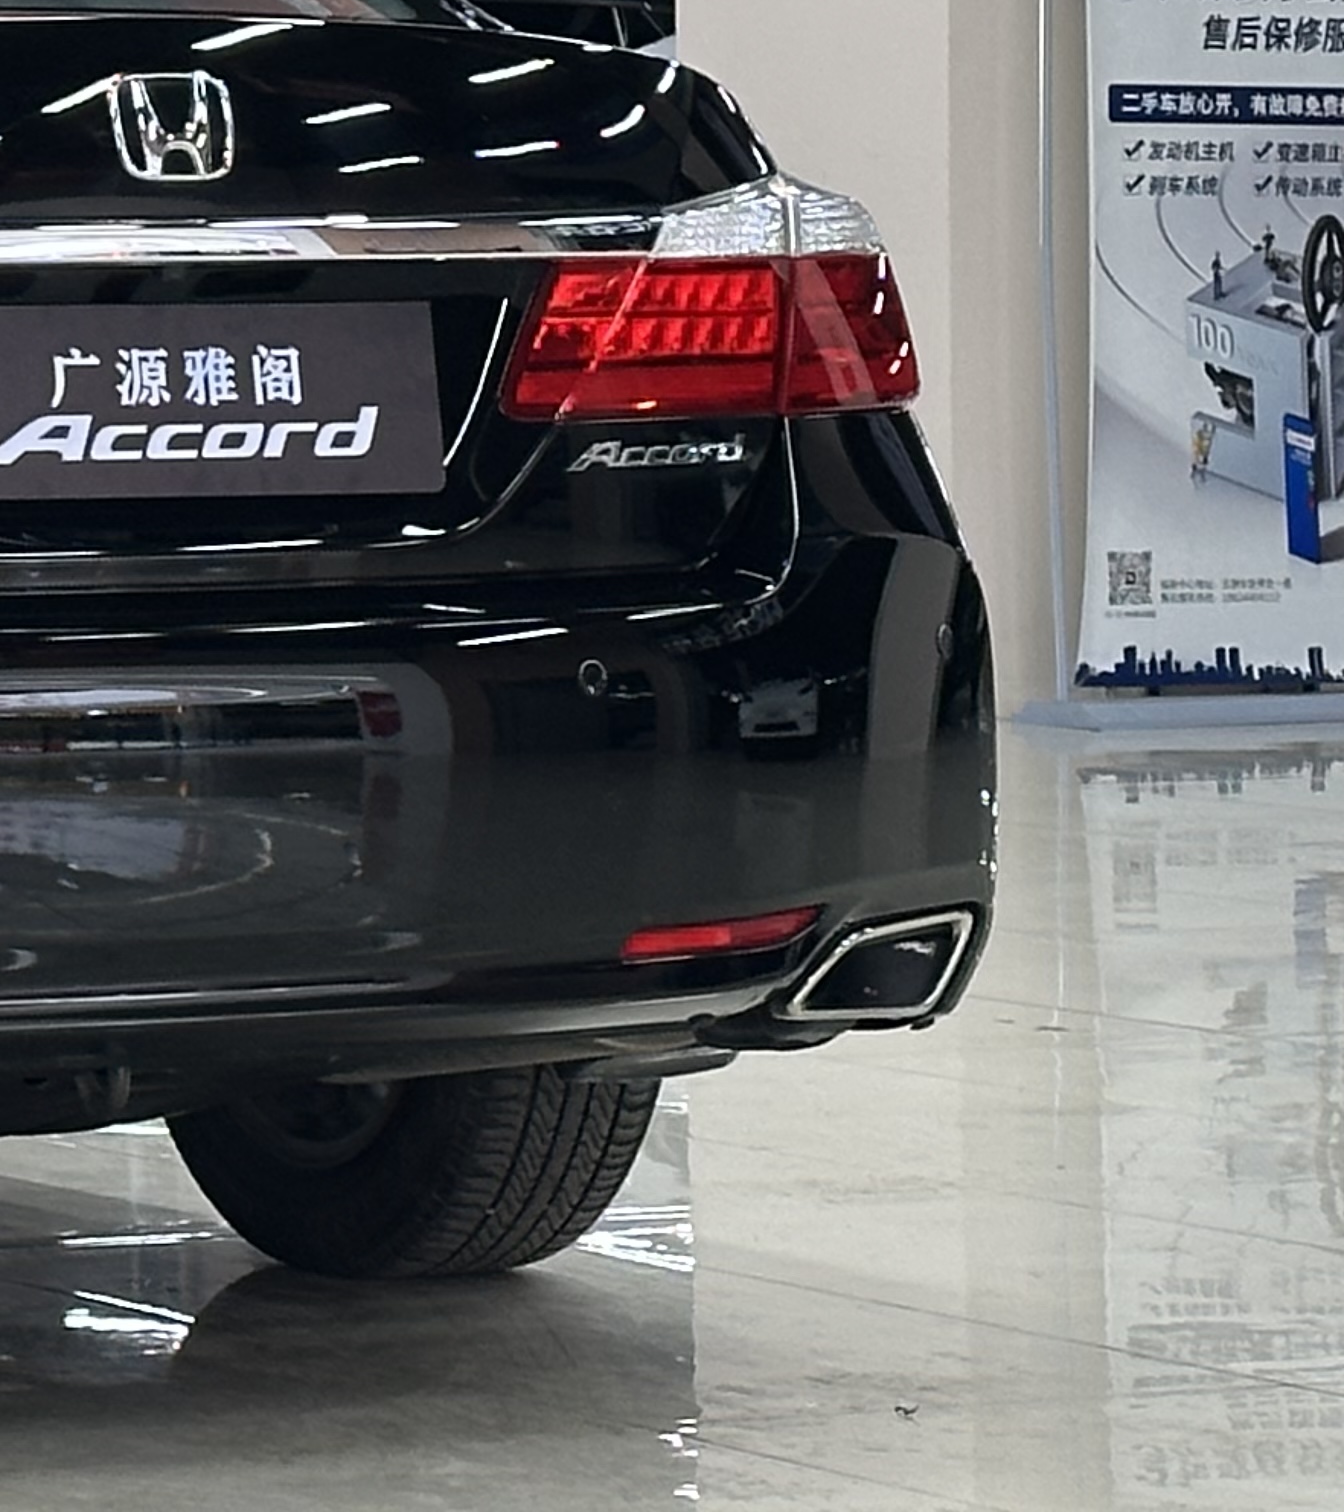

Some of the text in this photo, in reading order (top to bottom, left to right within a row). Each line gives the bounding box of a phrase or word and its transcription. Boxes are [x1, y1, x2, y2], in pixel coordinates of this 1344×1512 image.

[48, 344, 304, 409] 广源雅阁
[566, 433, 747, 473] Accord
